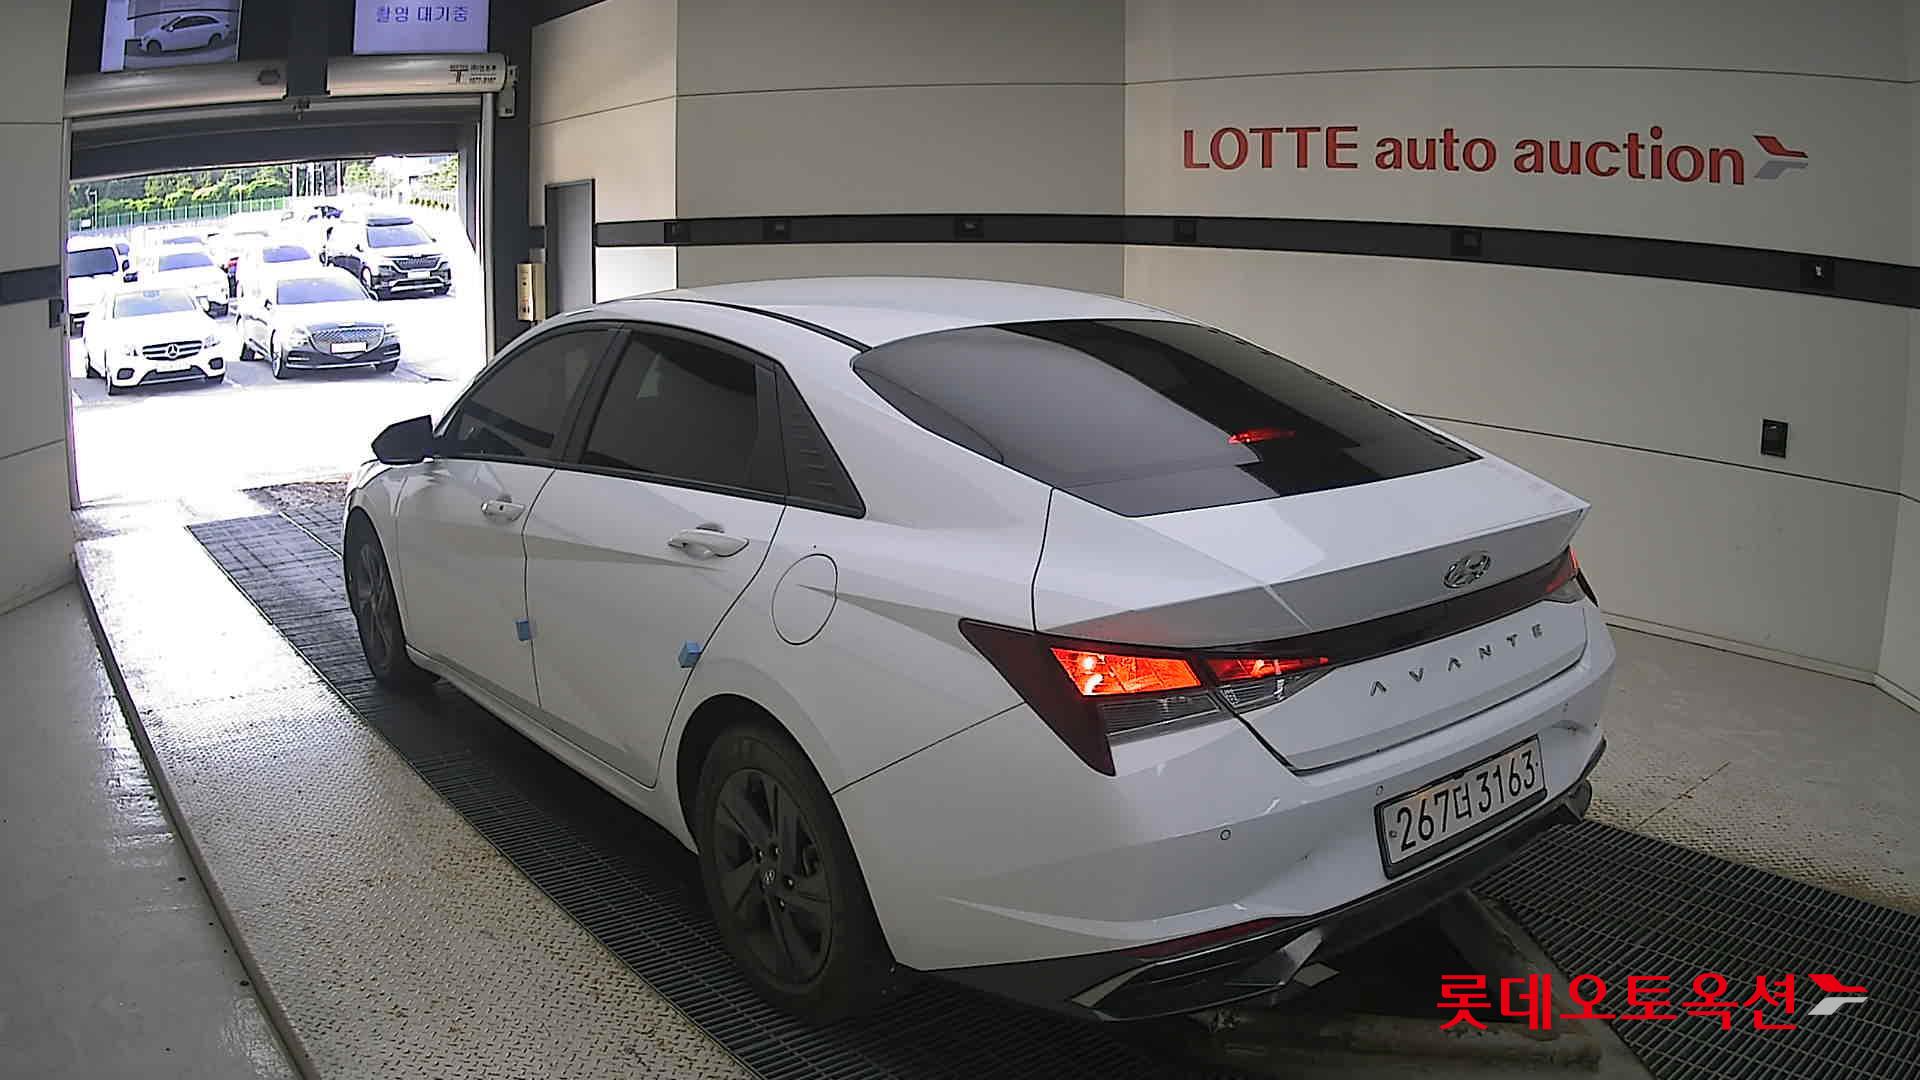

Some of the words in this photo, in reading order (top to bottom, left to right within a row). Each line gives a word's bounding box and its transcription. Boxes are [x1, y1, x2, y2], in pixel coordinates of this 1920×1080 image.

[417, 6, 468, 23] 대기중
[1183, 126, 1358, 170] LOTTE
[1374, 128, 1497, 172] auto
[1513, 126, 1745, 185] auction
[1369, 623, 1545, 696] AVANTE
